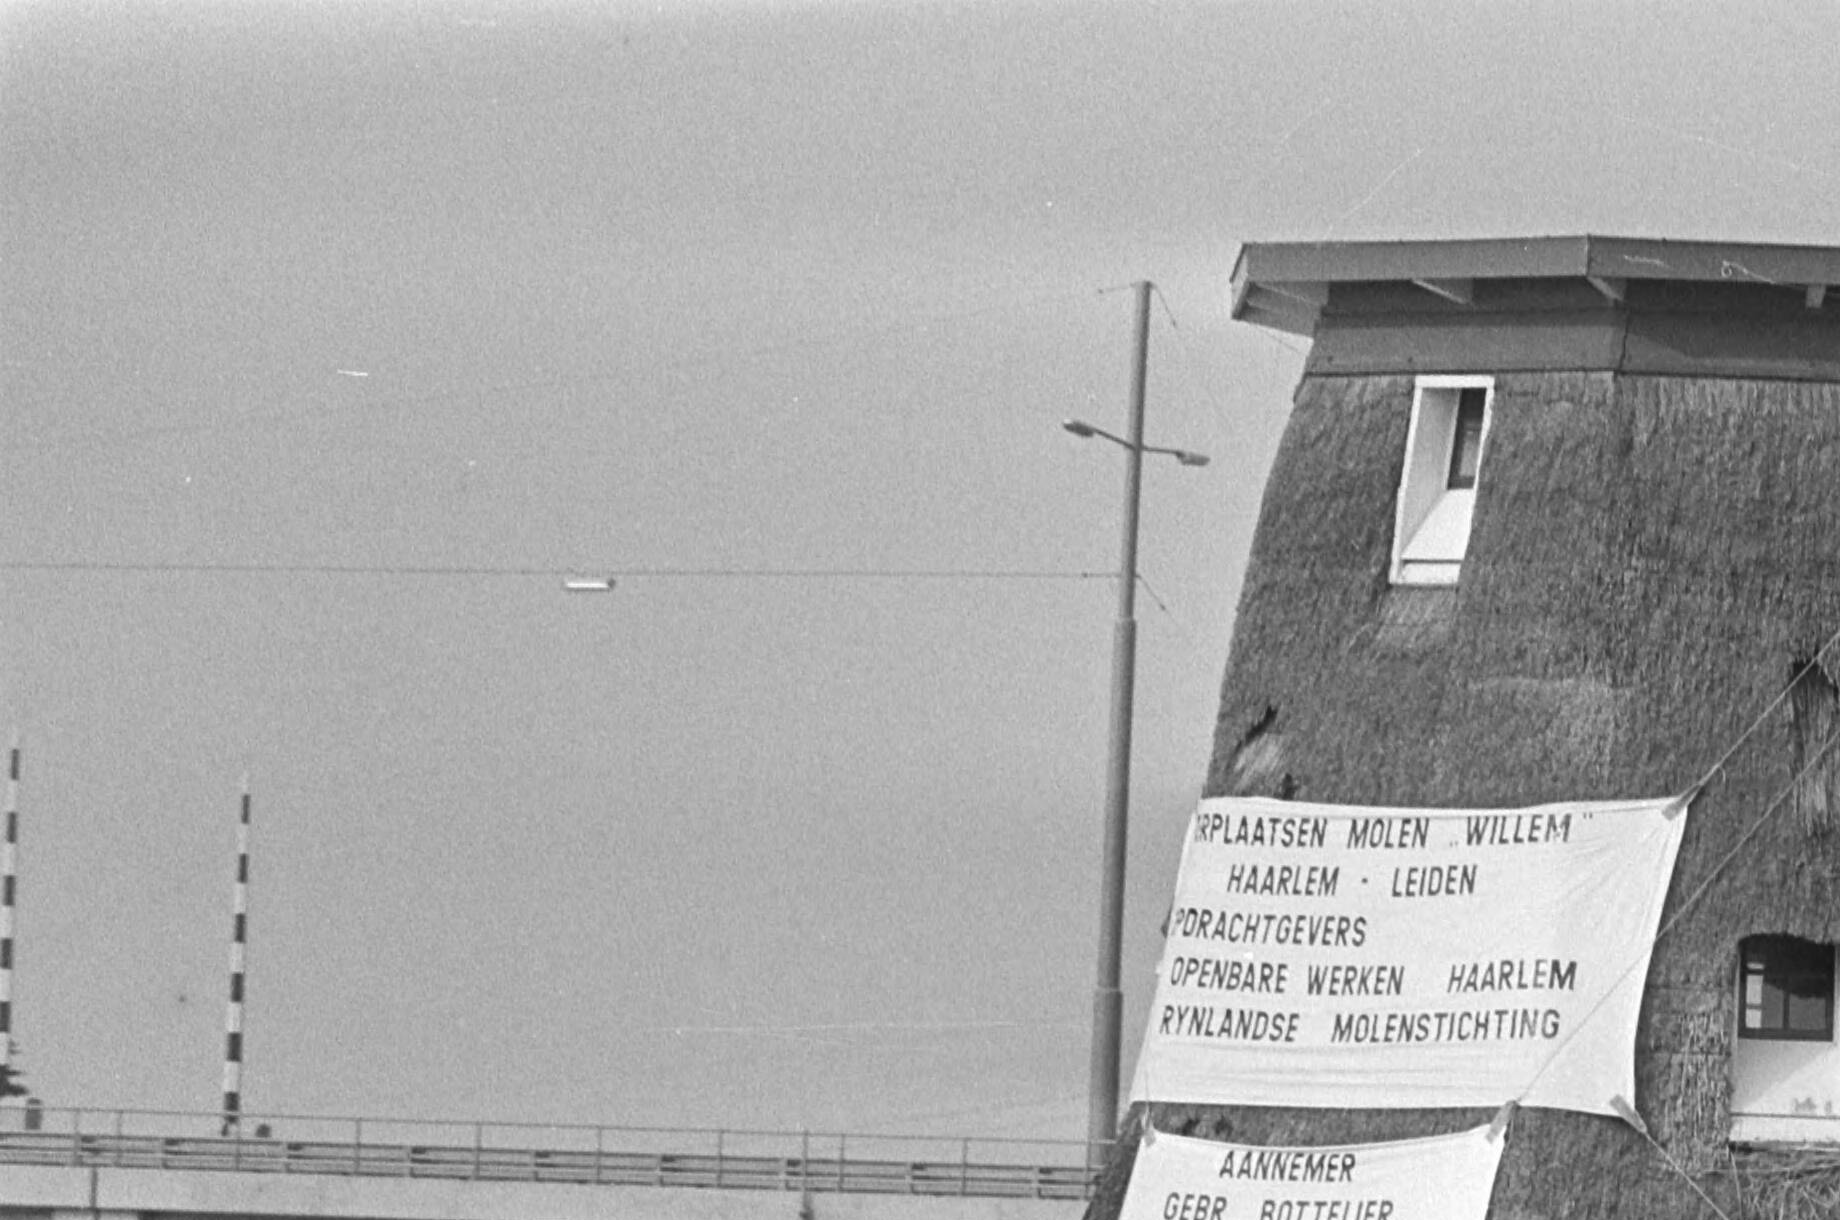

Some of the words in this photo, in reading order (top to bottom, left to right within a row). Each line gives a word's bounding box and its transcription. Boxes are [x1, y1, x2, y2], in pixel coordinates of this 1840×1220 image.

[1346, 816, 1430, 850] MOLEN
[1226, 864, 1339, 897] HAARLEM
[1391, 864, 1477, 898] LEIDEN
[1170, 956, 1288, 995] OPENBARE
[1306, 964, 1405, 996] WERKEN
[1446, 959, 1578, 993] HAARLEM
[1158, 1004, 1300, 1043] RYNLANDSE
[1330, 1007, 1561, 1044] MOLENSTICHTING
[1218, 1149, 1356, 1183] AANNEMER
